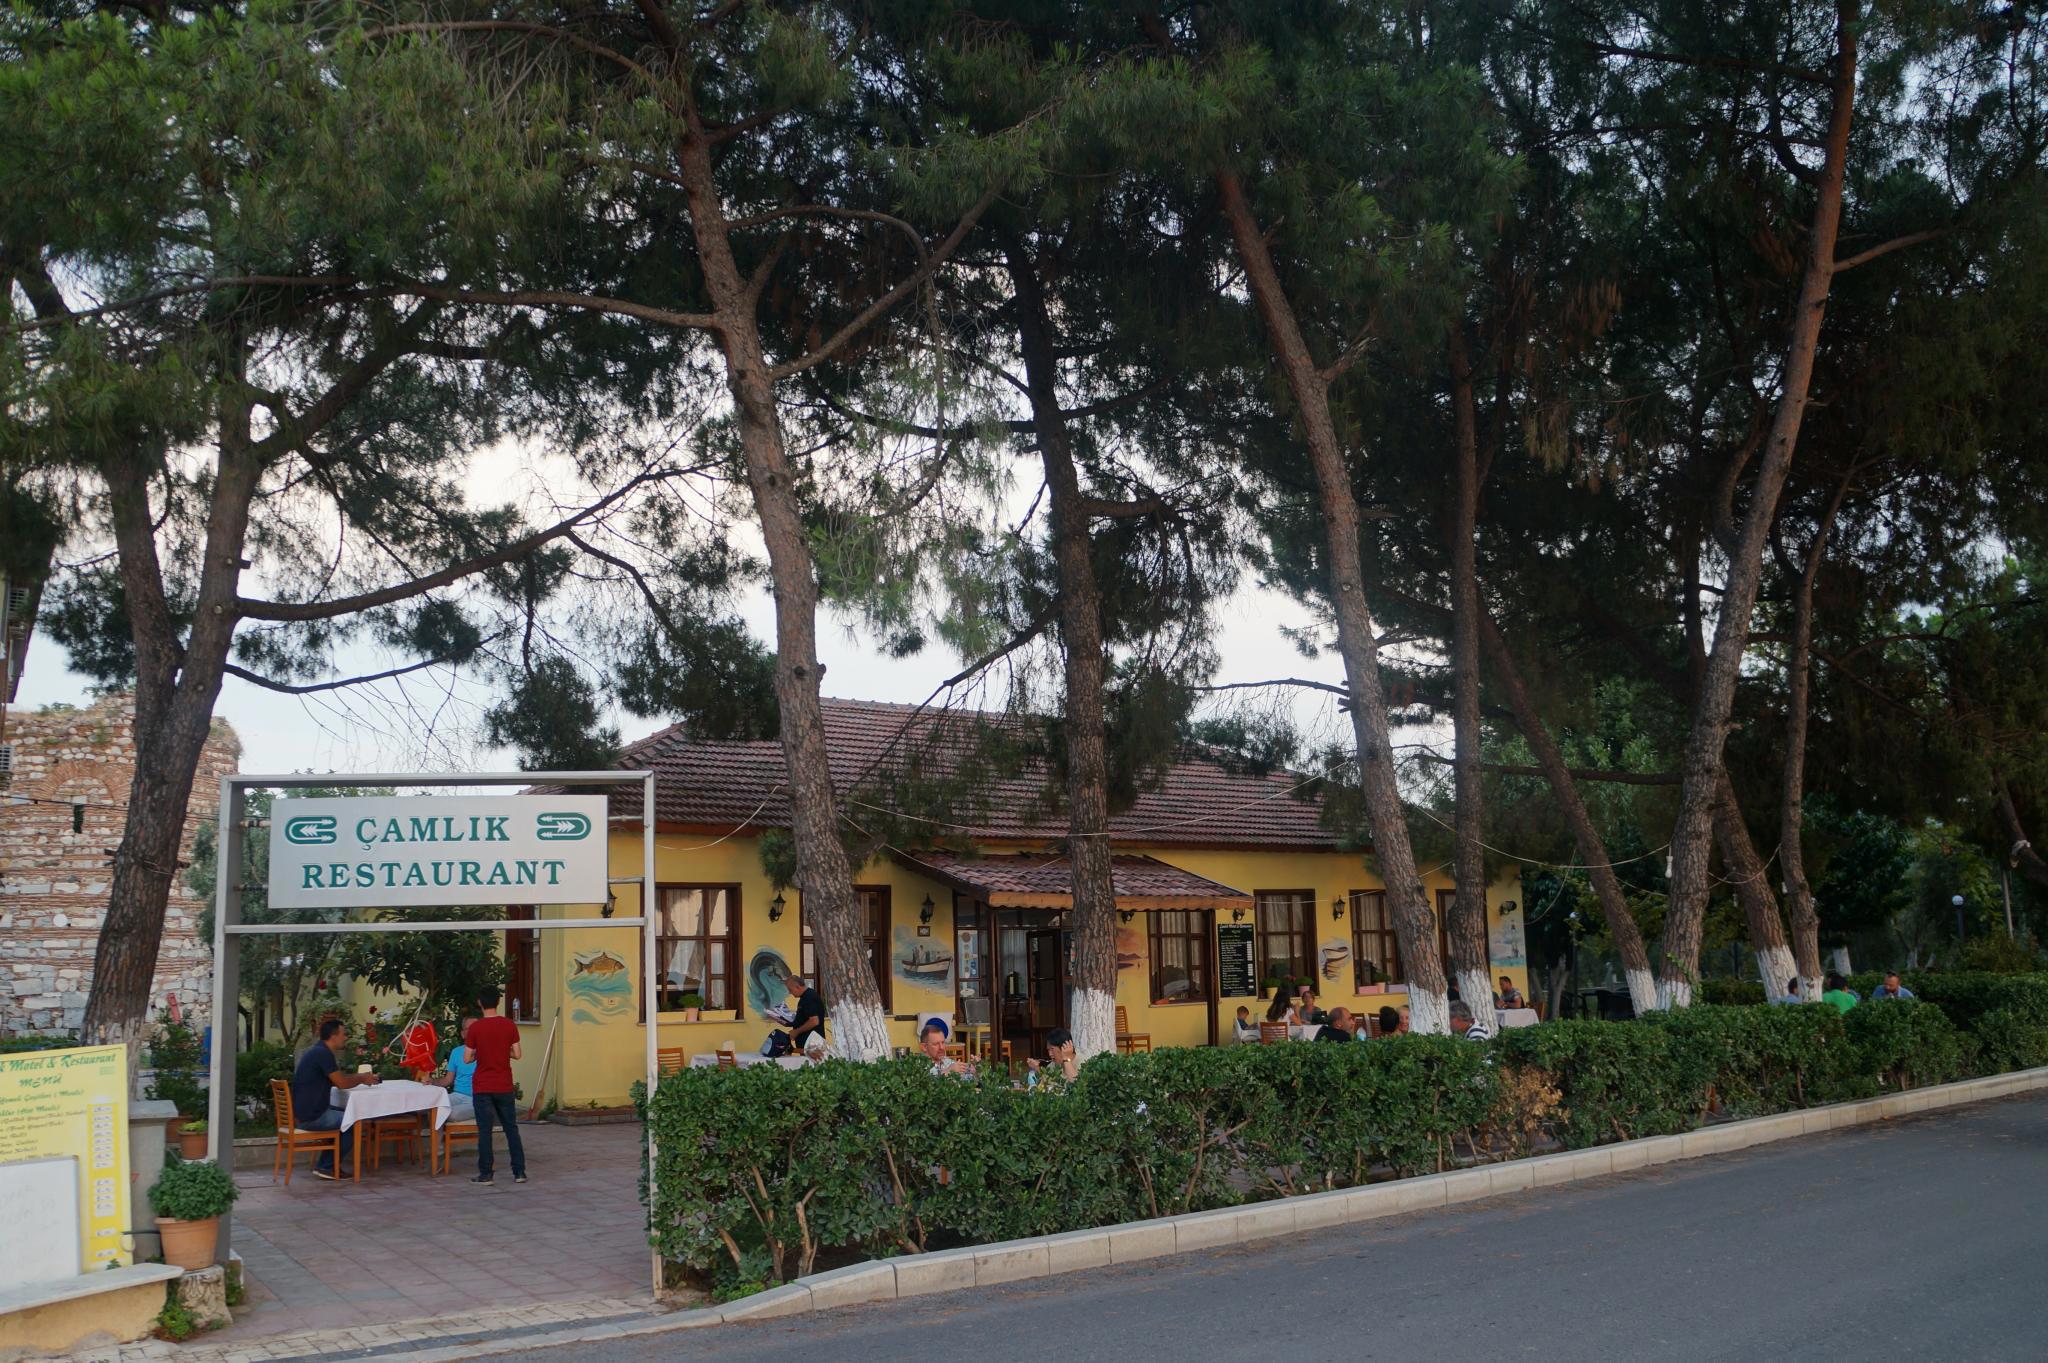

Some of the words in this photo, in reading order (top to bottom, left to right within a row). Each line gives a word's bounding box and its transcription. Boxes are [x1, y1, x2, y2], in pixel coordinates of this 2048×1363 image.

[356, 816, 510, 851] ÇAMLIK
[301, 861, 566, 888] RESTAURANT
[9, 1059, 43, 1071] Motel
[46, 1056, 55, 1068] &
[58, 1054, 116, 1068] Restaurant
